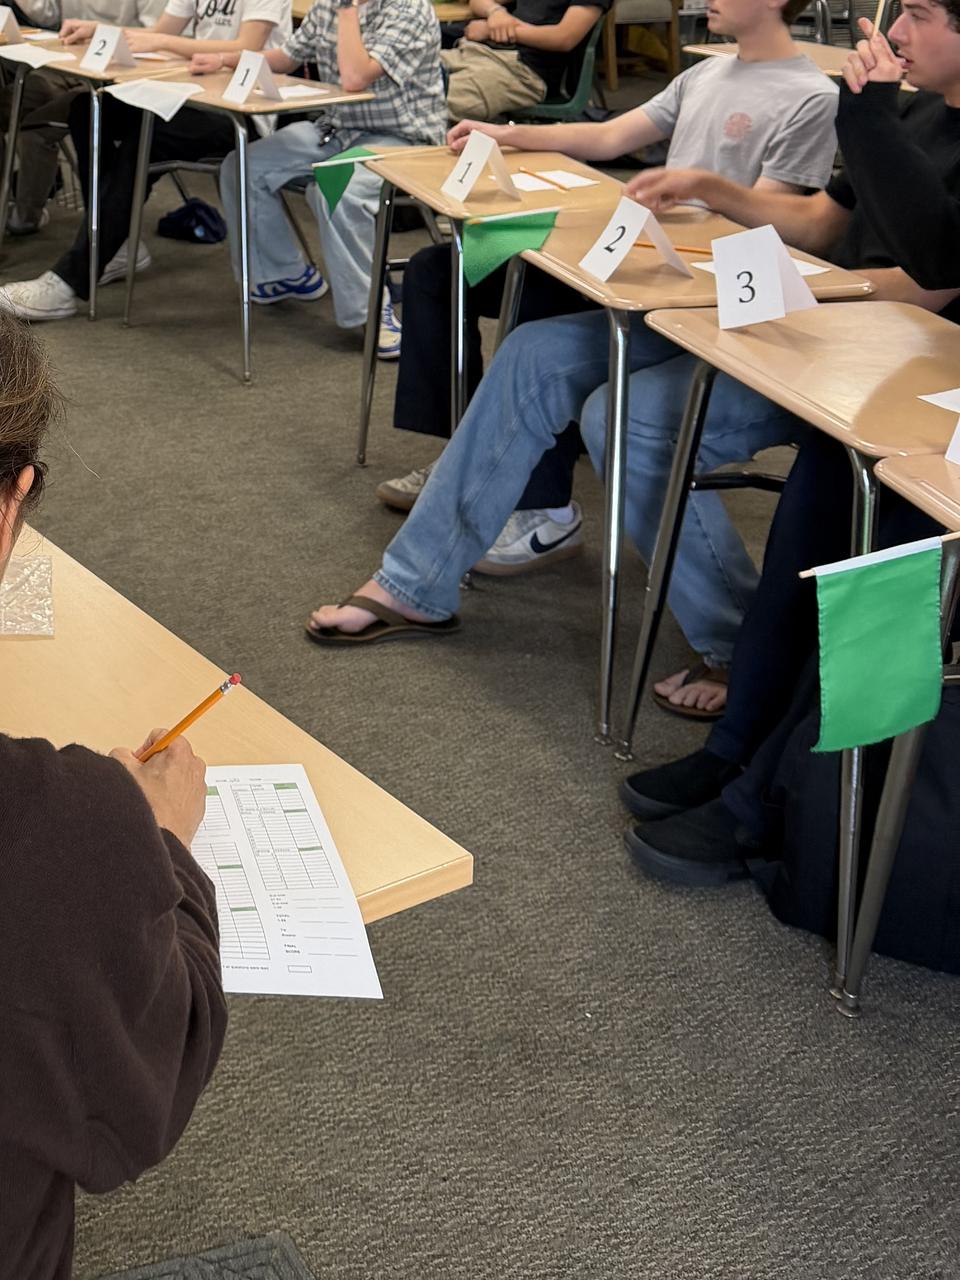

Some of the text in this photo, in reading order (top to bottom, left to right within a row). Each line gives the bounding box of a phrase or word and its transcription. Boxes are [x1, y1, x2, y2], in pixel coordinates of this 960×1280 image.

[93, 39, 106, 56] 2
[240, 68, 250, 87] 1
[457, 162, 472, 184] 1
[603, 225, 627, 253] 2
[736, 270, 756, 304] 3
